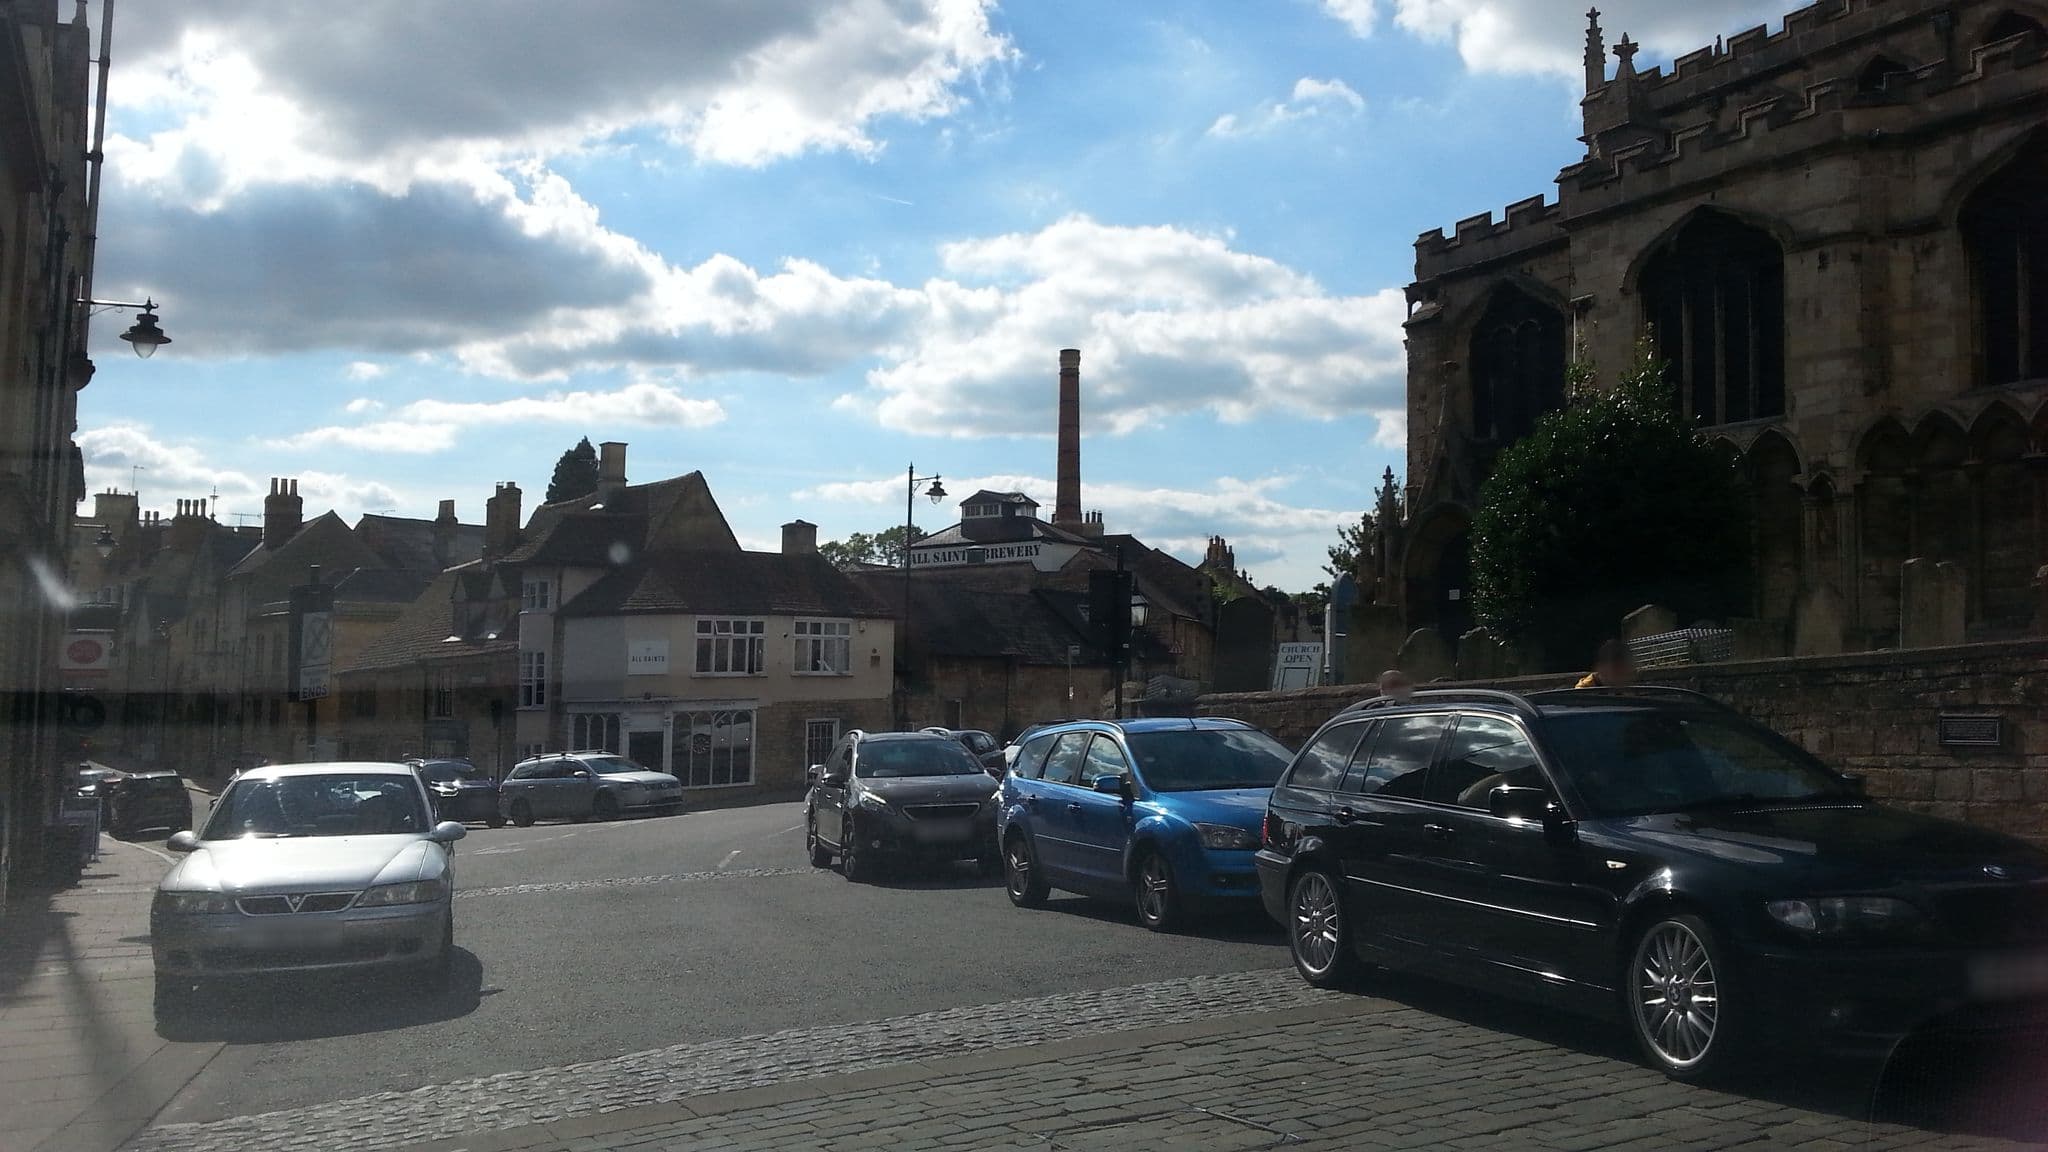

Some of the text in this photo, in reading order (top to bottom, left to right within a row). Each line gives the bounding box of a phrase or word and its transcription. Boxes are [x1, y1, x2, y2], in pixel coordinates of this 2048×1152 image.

[911, 553, 930, 564] ALL
[933, 550, 967, 563] SAINT
[1281, 645, 1320, 653] CHURCH
[1284, 654, 1312, 663] OPEN
